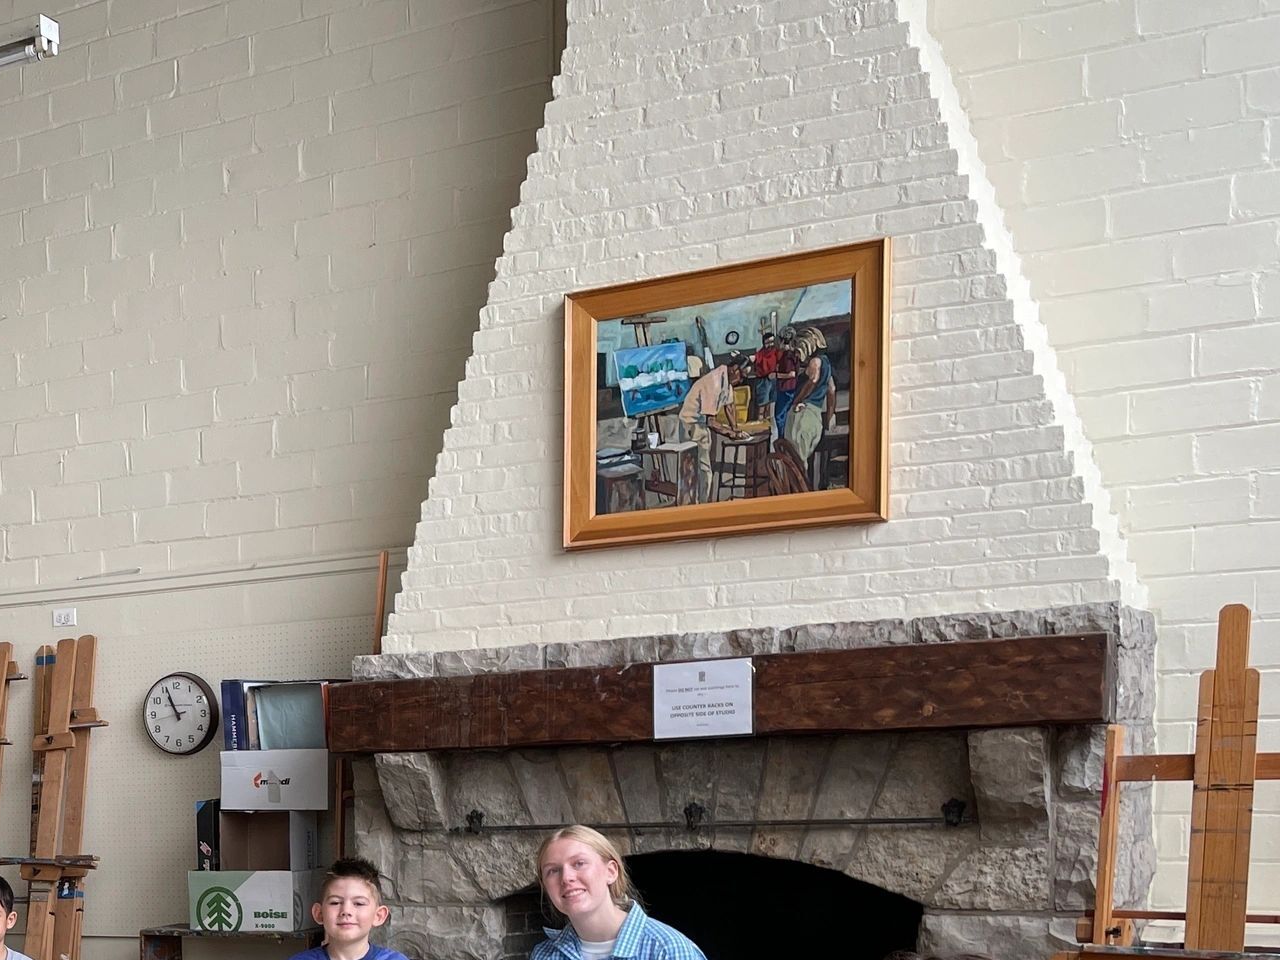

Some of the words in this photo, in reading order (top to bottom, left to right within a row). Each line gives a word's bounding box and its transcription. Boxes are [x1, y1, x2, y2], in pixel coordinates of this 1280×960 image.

[172, 681, 181, 690] 12
[153, 697, 162, 705] 10
[196, 695, 202, 704] 2
[260, 777, 290, 785] mdi
